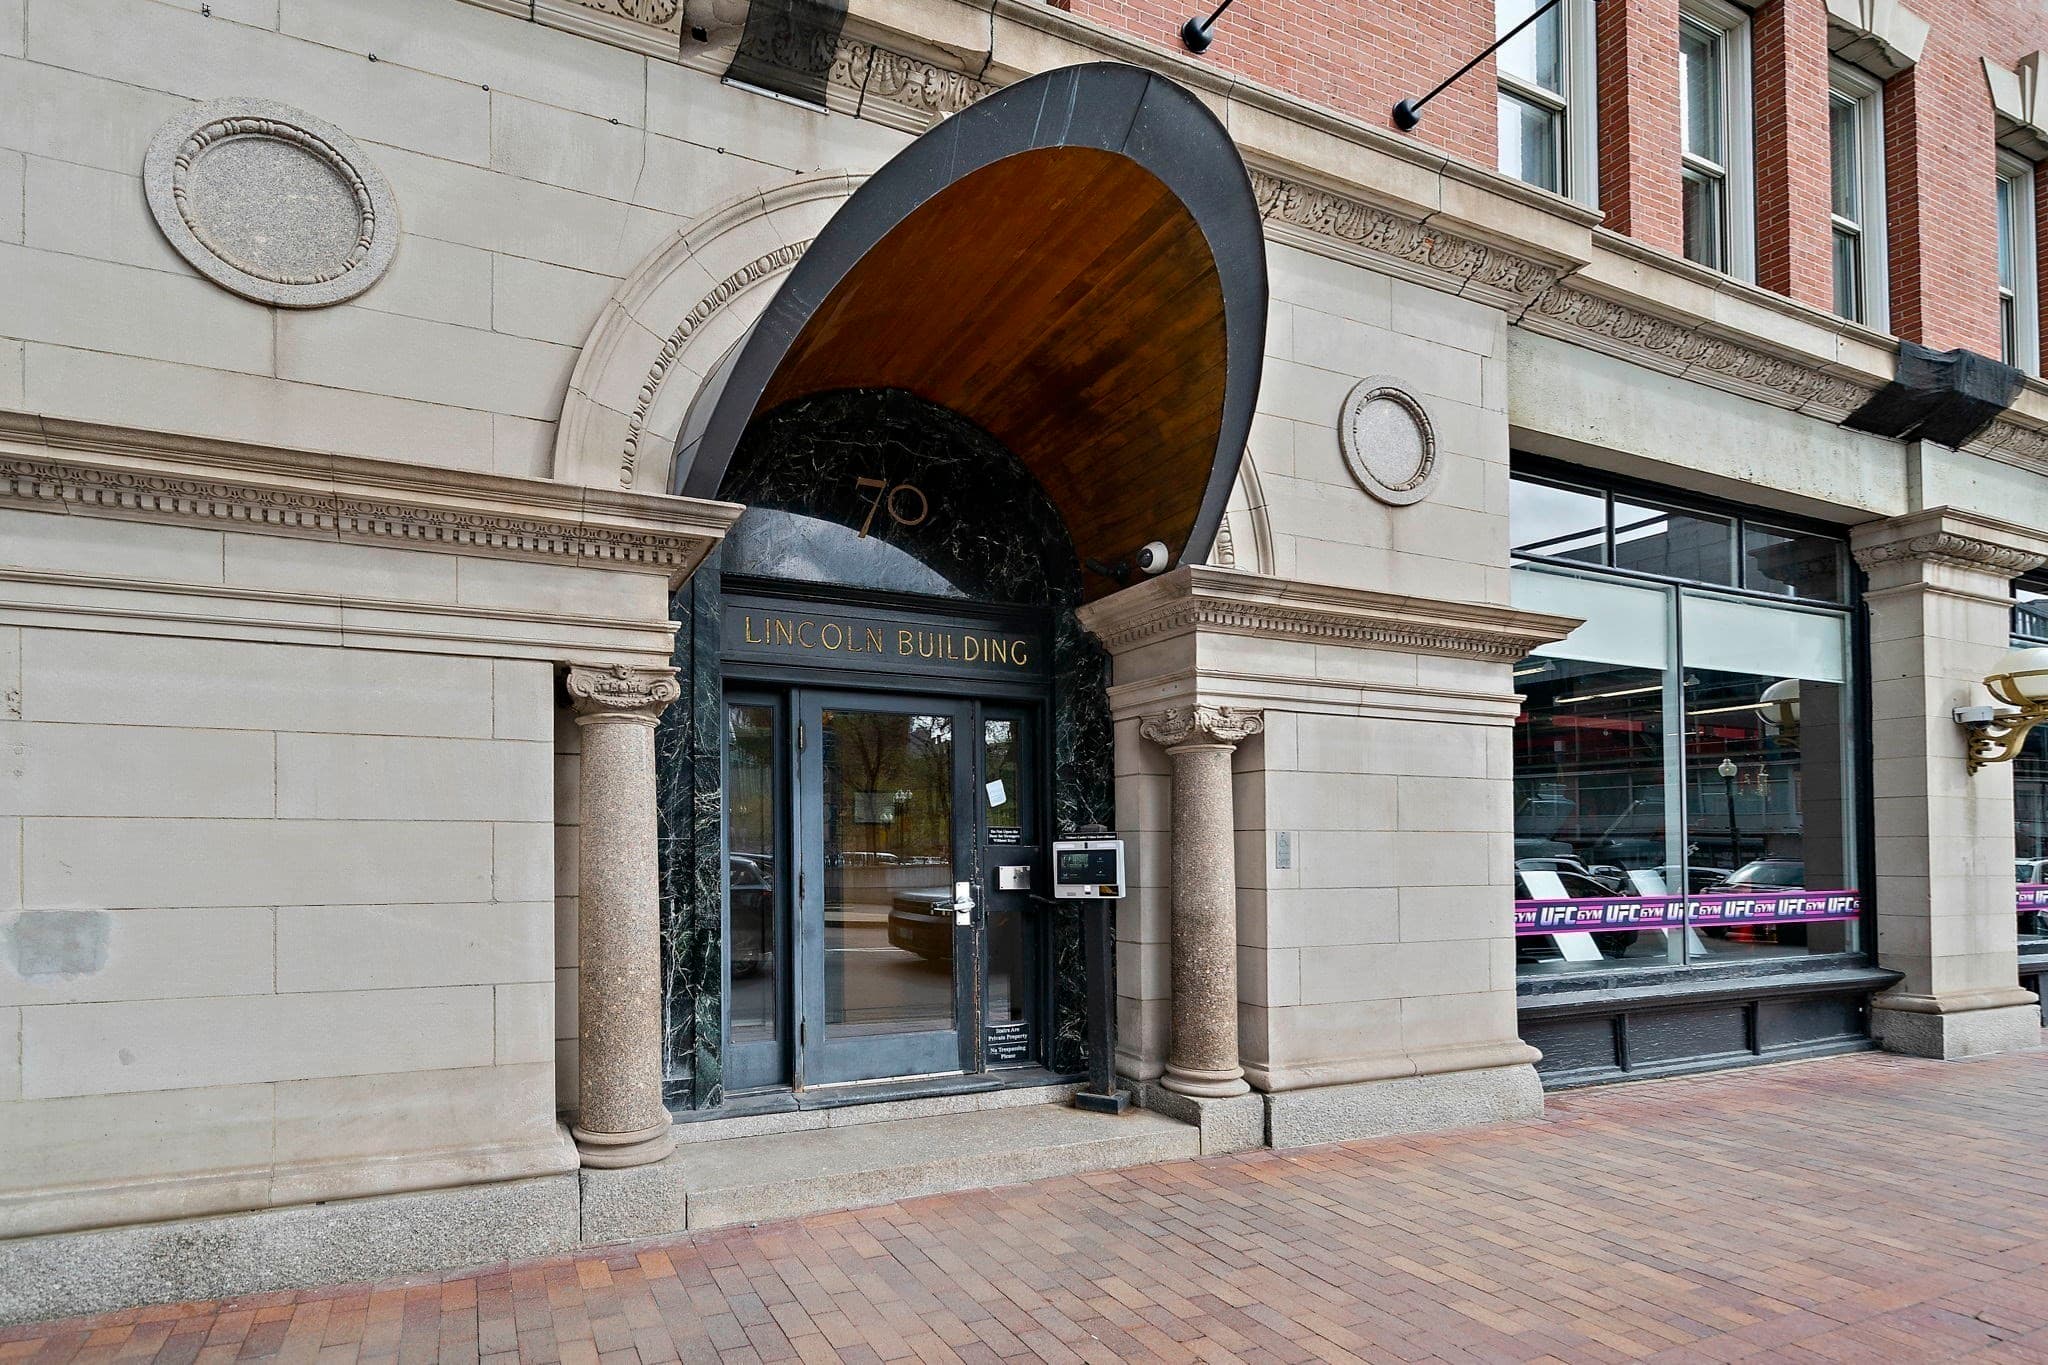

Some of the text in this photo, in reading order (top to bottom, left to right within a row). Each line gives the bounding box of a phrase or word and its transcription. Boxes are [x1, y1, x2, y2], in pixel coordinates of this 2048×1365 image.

[856, 477, 928, 538] 70
[745, 616, 1028, 666] LINCOLN BUILDING
[1540, 906, 1578, 926] UFC
[1577, 909, 1603, 921] GYM
[1606, 904, 1641, 923] UFC
[1640, 907, 1665, 918] GYM
[1700, 904, 1722, 916] GYM
[1724, 900, 1755, 918] UFC
[1754, 903, 1776, 914] GYM
[1778, 898, 1807, 916] UFC
[1806, 901, 1825, 912] GYM
[1827, 897, 1854, 914] UFC
